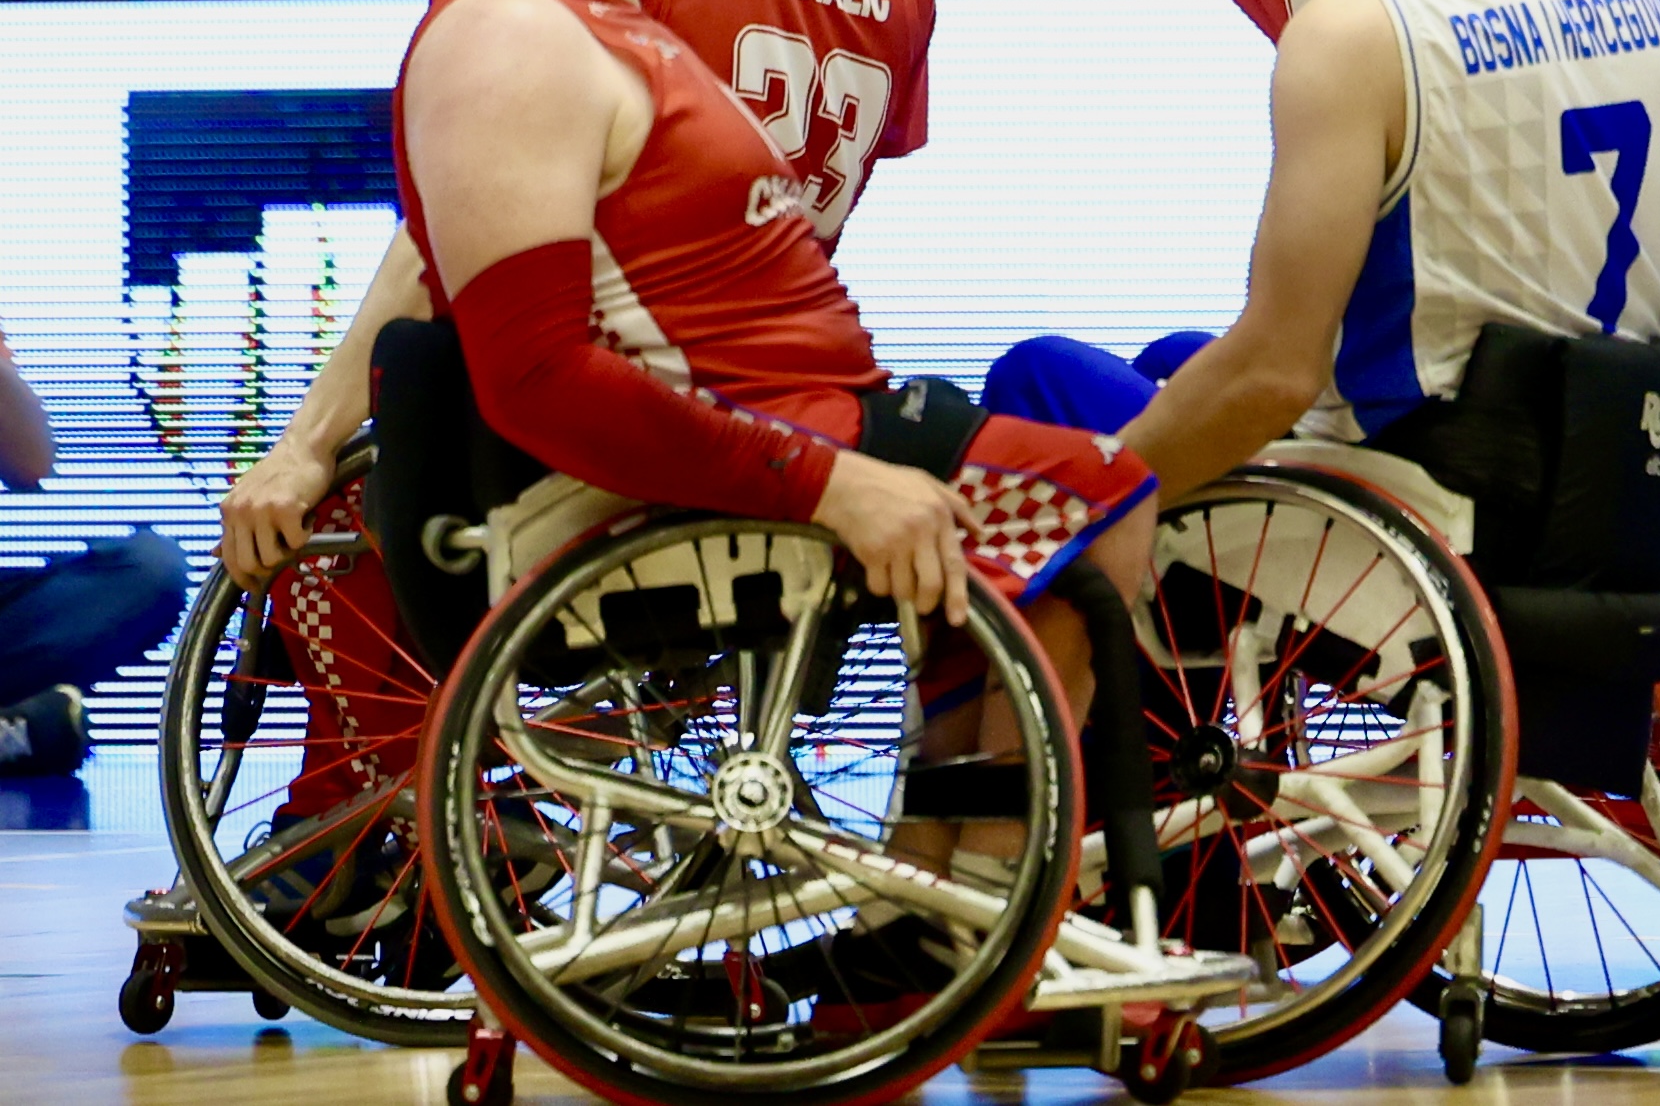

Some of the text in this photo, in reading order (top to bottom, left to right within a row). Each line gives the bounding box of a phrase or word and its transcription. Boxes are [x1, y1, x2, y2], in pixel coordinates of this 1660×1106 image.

[732, 24, 892, 240] 23
[1448, 2, 1549, 75] BOSNA
[1561, 100, 1652, 334] 7
